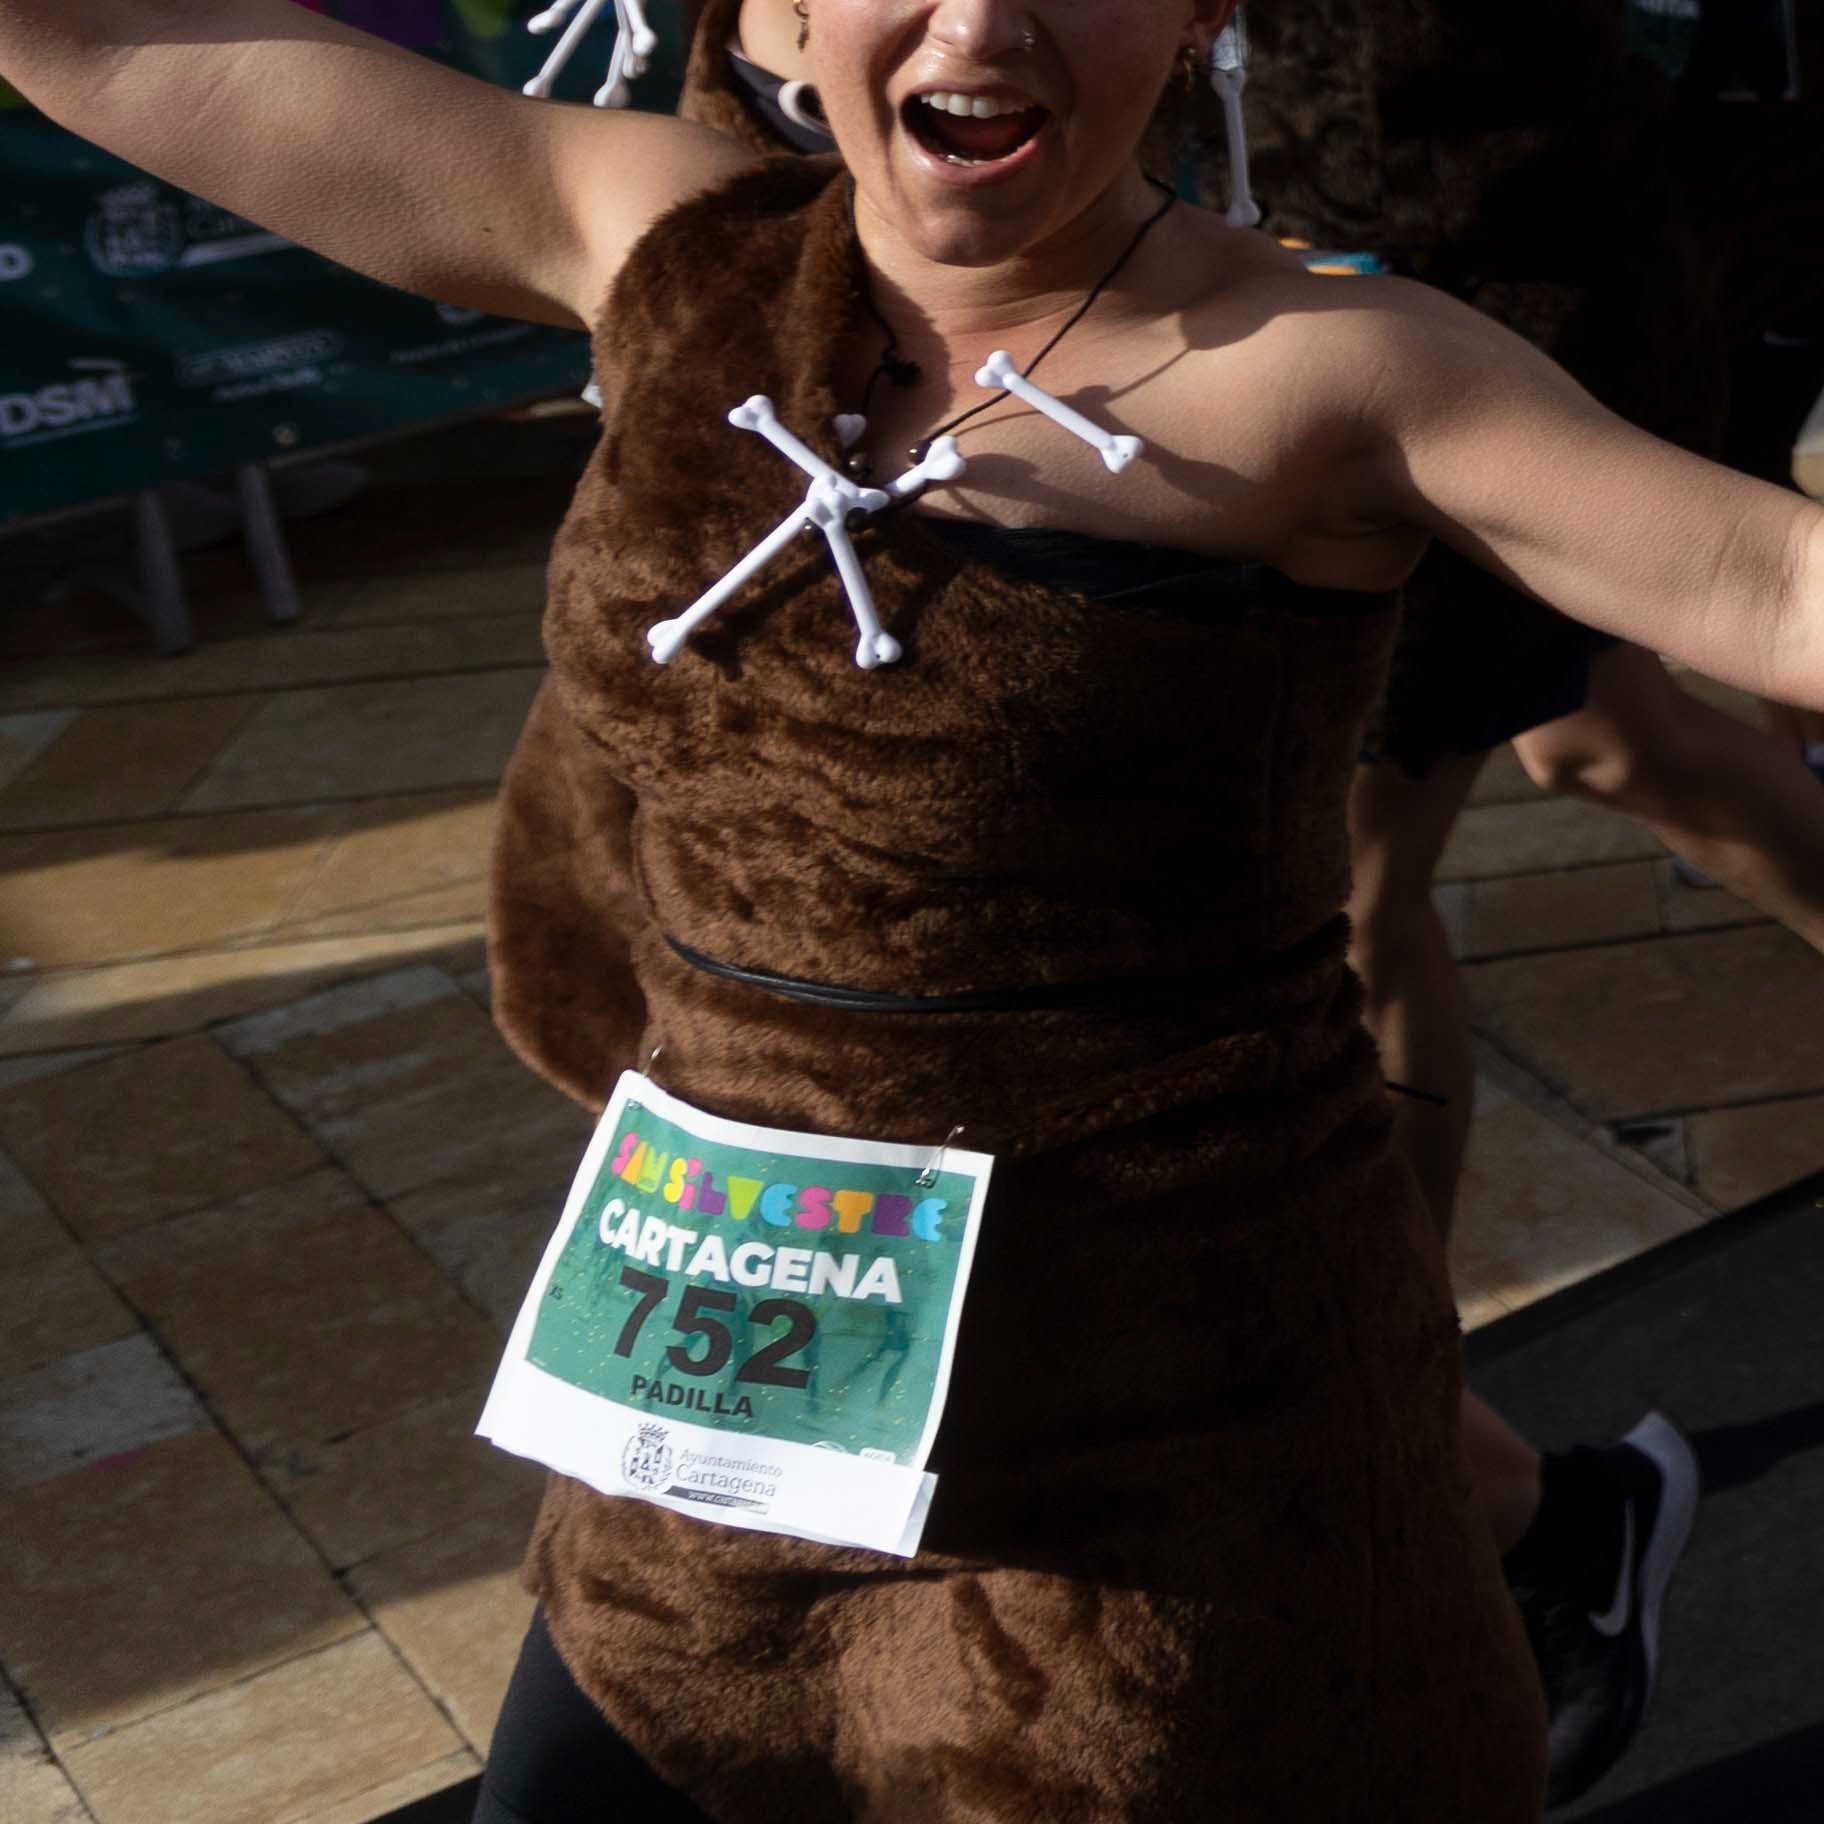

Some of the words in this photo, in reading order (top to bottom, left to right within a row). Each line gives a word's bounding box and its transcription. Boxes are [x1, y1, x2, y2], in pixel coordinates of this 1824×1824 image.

[612, 1131, 669, 1193] SAN
[600, 1198, 902, 1304] CARTAGENA
[614, 1266, 818, 1389] 752
[630, 1374, 754, 1419] PADILLA
[675, 1464, 776, 1497] Cartagena
[679, 1448, 783, 1478] Ayuntamiento
